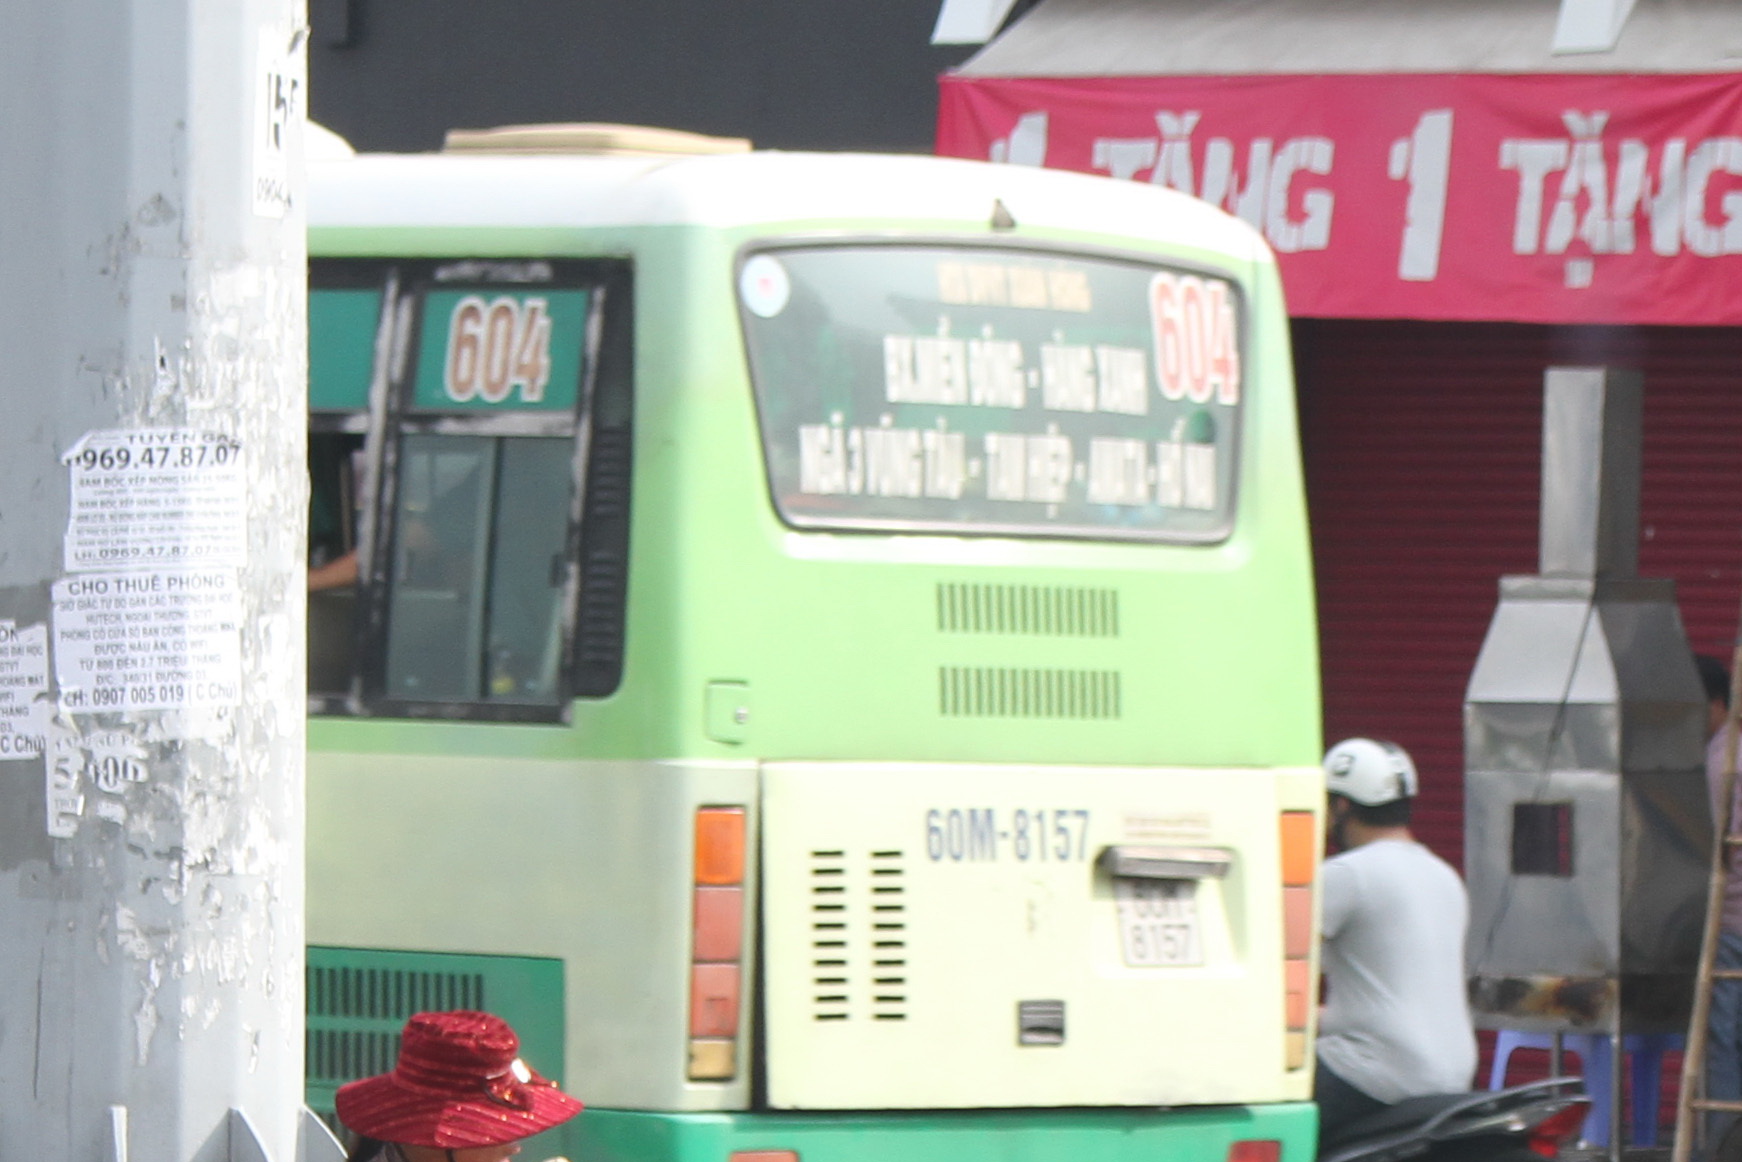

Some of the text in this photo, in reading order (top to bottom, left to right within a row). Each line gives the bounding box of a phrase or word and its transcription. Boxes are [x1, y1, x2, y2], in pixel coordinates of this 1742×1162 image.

[1388, 109, 1454, 281] 1
[445, 295, 552, 403] 604
[1150, 272, 1240, 406] 604
[68, 573, 225, 596] CHO THUÊ PHÒNG
[92, 686, 126, 706] 0907
[131, 685, 155, 703] 005
[159, 685, 185, 703] 019
[925, 808, 1091, 862] 60M-8157
[1130, 923, 1190, 960] 8157
